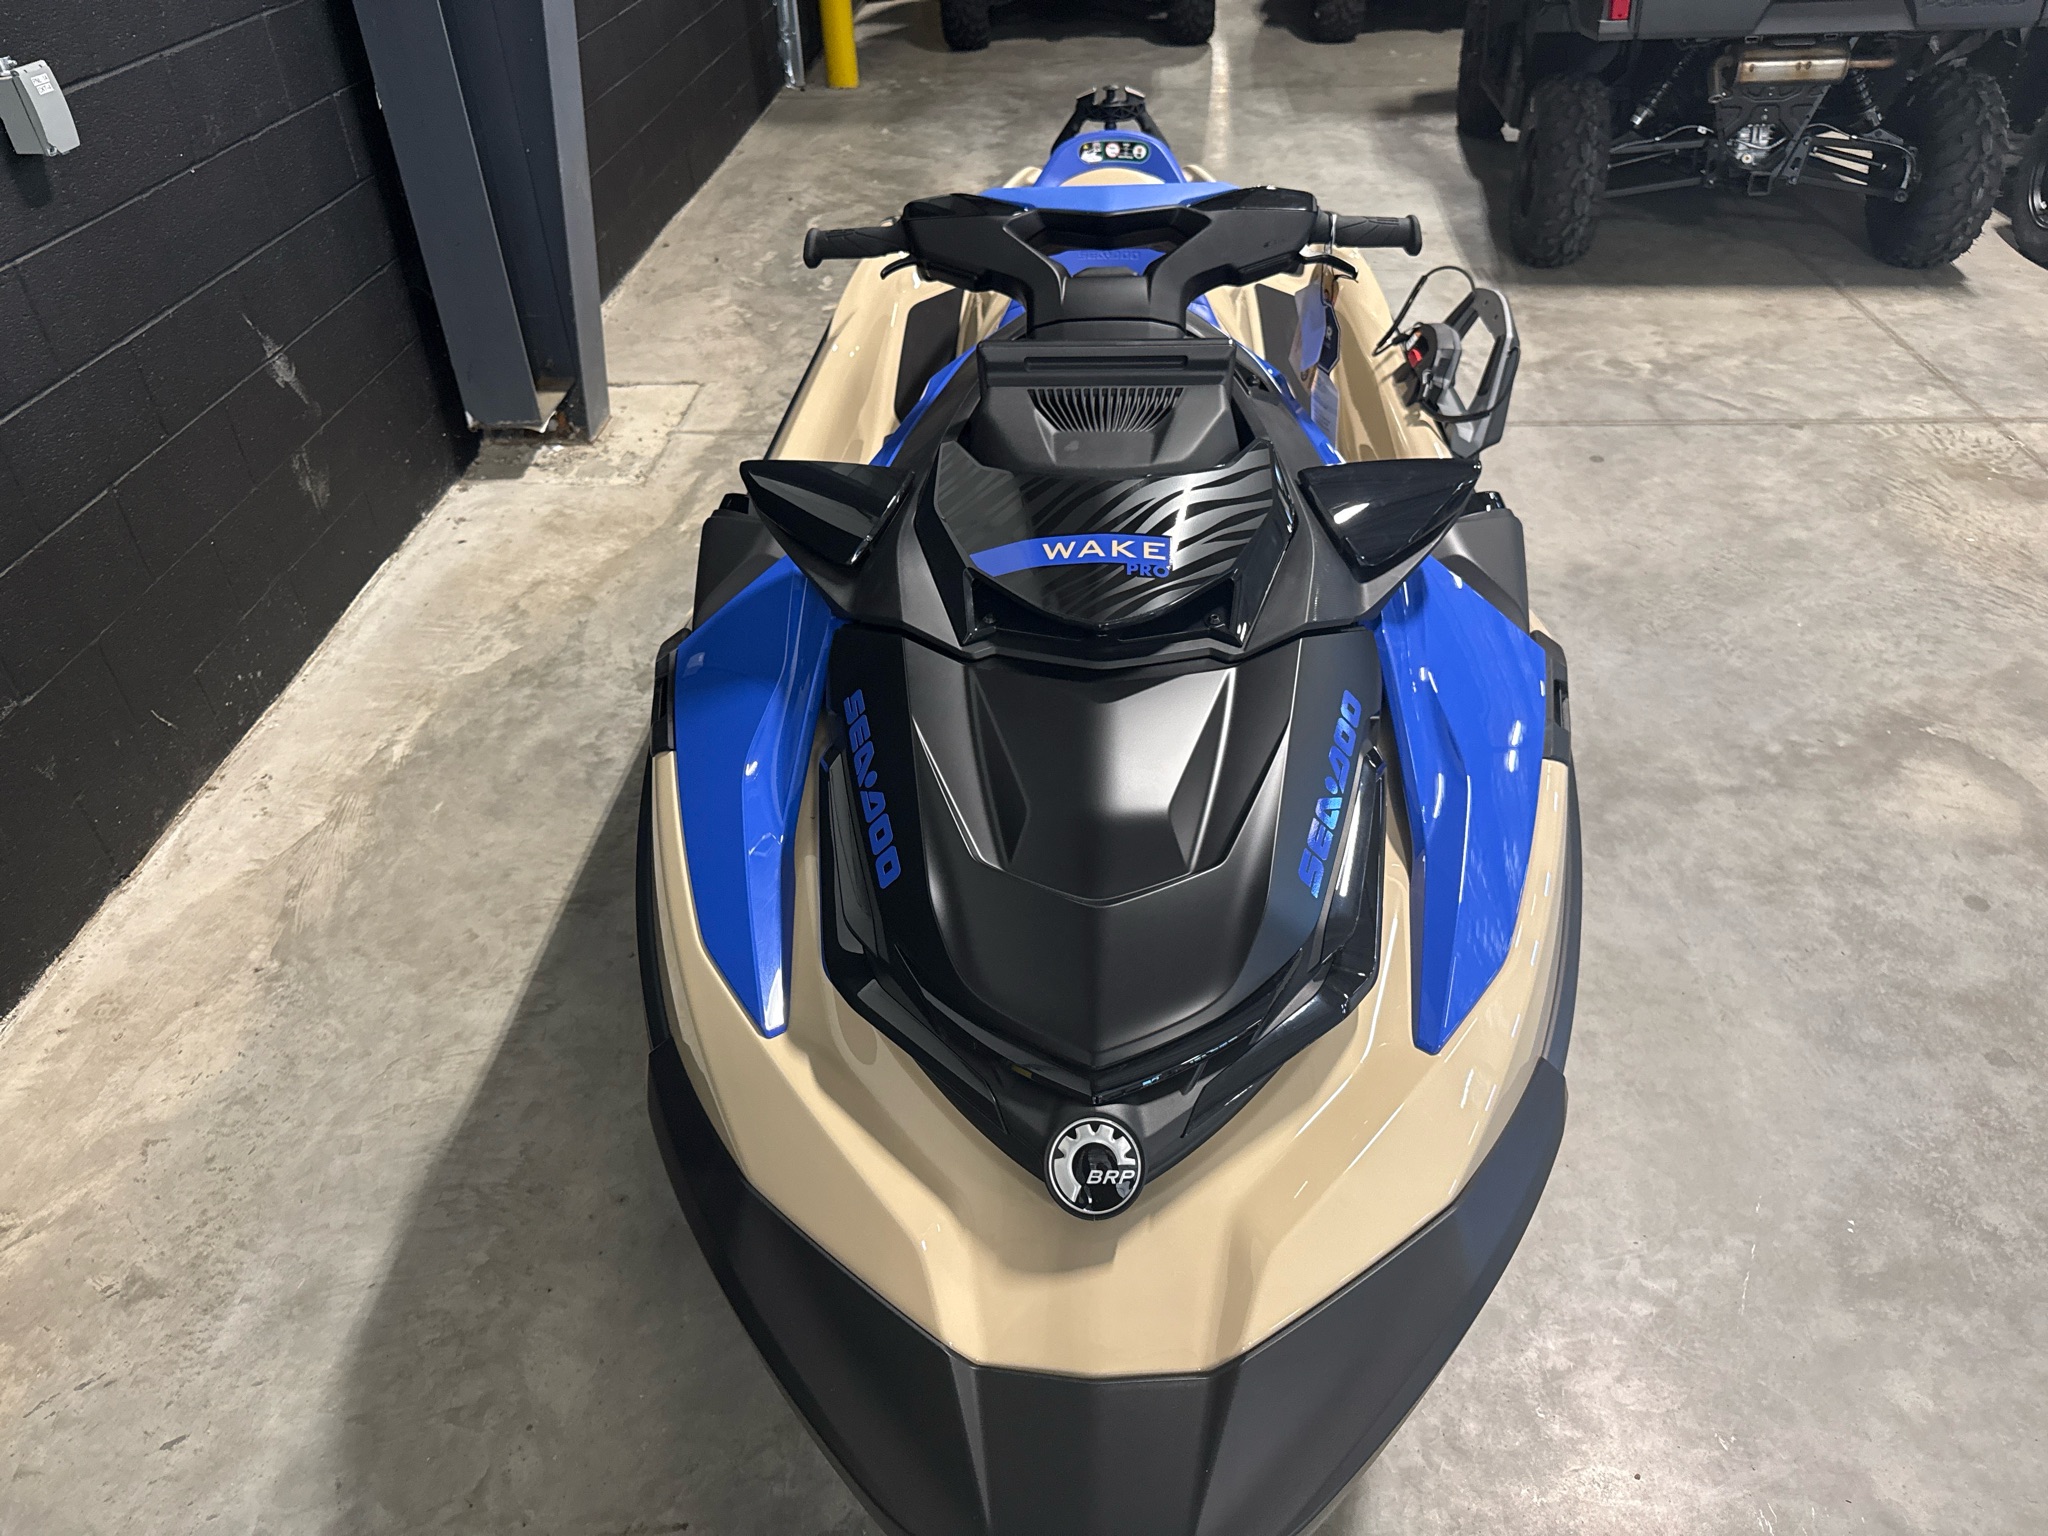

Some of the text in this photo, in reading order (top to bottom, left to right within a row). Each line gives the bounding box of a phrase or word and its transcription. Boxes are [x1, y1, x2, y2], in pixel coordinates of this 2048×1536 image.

[1042, 540, 1166, 560] WAKE
[1126, 563, 1169, 578] PRO
[1086, 1169, 1136, 1185] BRP
